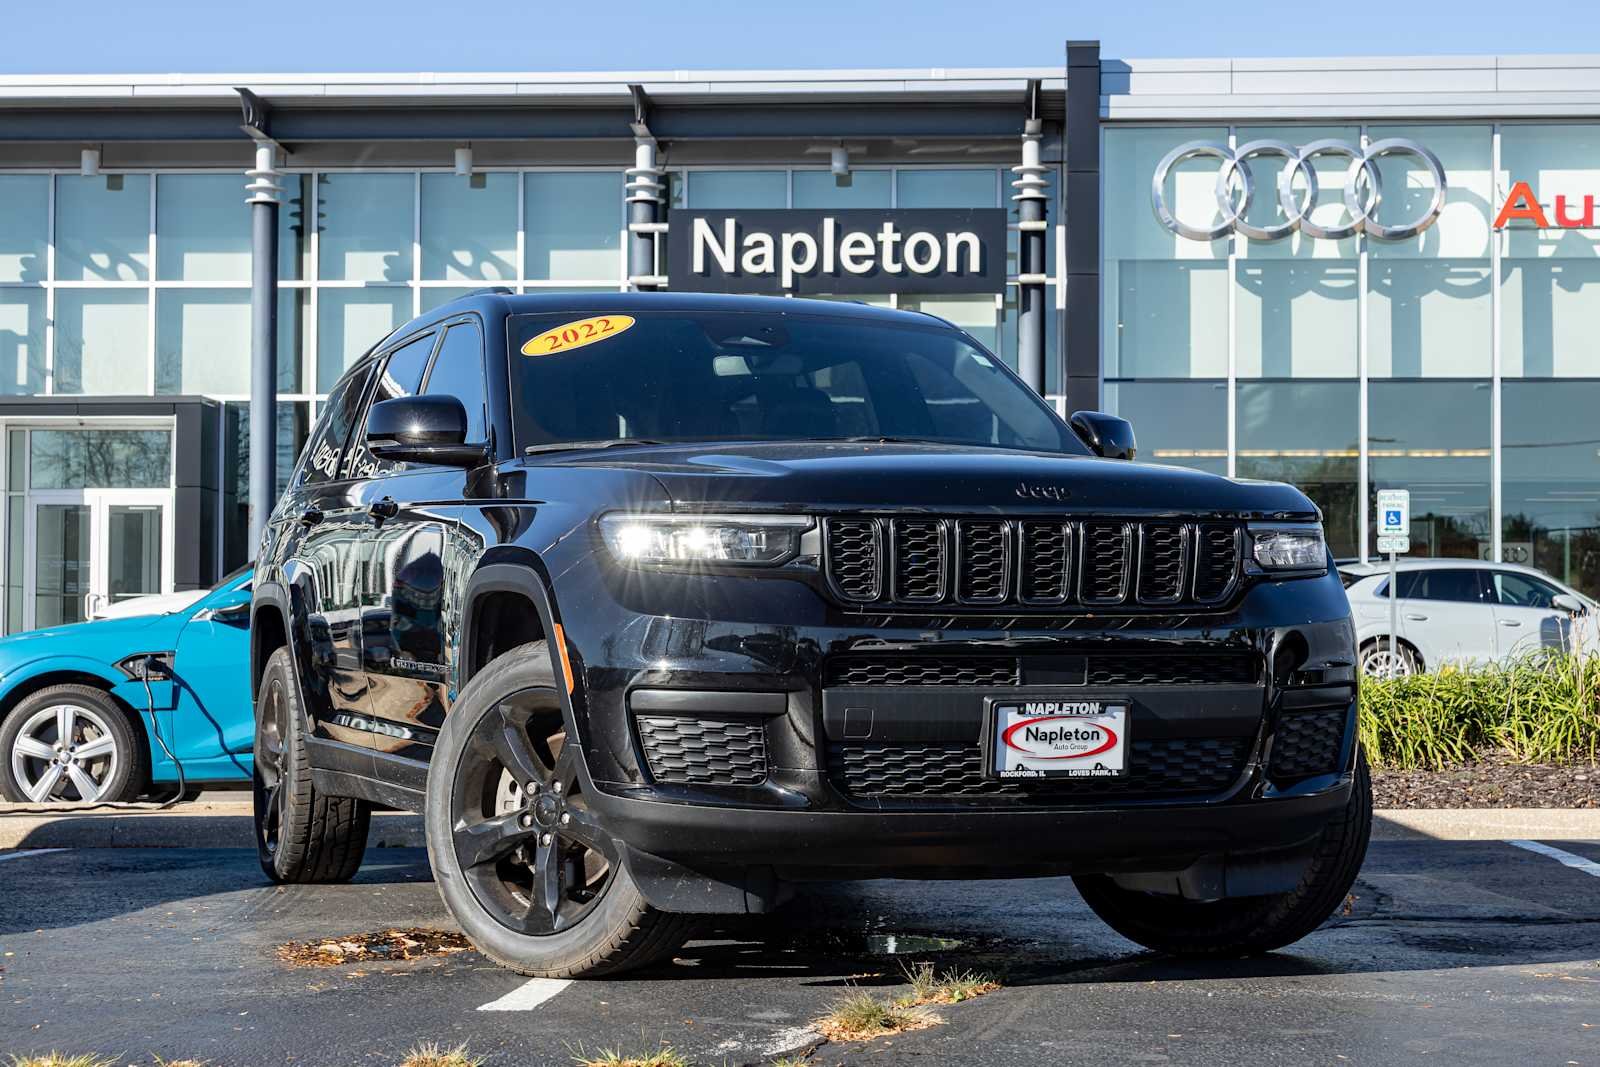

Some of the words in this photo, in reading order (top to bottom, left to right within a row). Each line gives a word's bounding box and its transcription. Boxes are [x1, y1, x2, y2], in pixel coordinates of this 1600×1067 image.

[693, 217, 981, 288] Napleton
[544, 319, 615, 351] 2022
[1015, 482, 1069, 502] Jeep
[1025, 702, 1100, 715] NAPLETON
[1025, 726, 1100, 744] Napleton
[1070, 743, 1088, 751] Group
